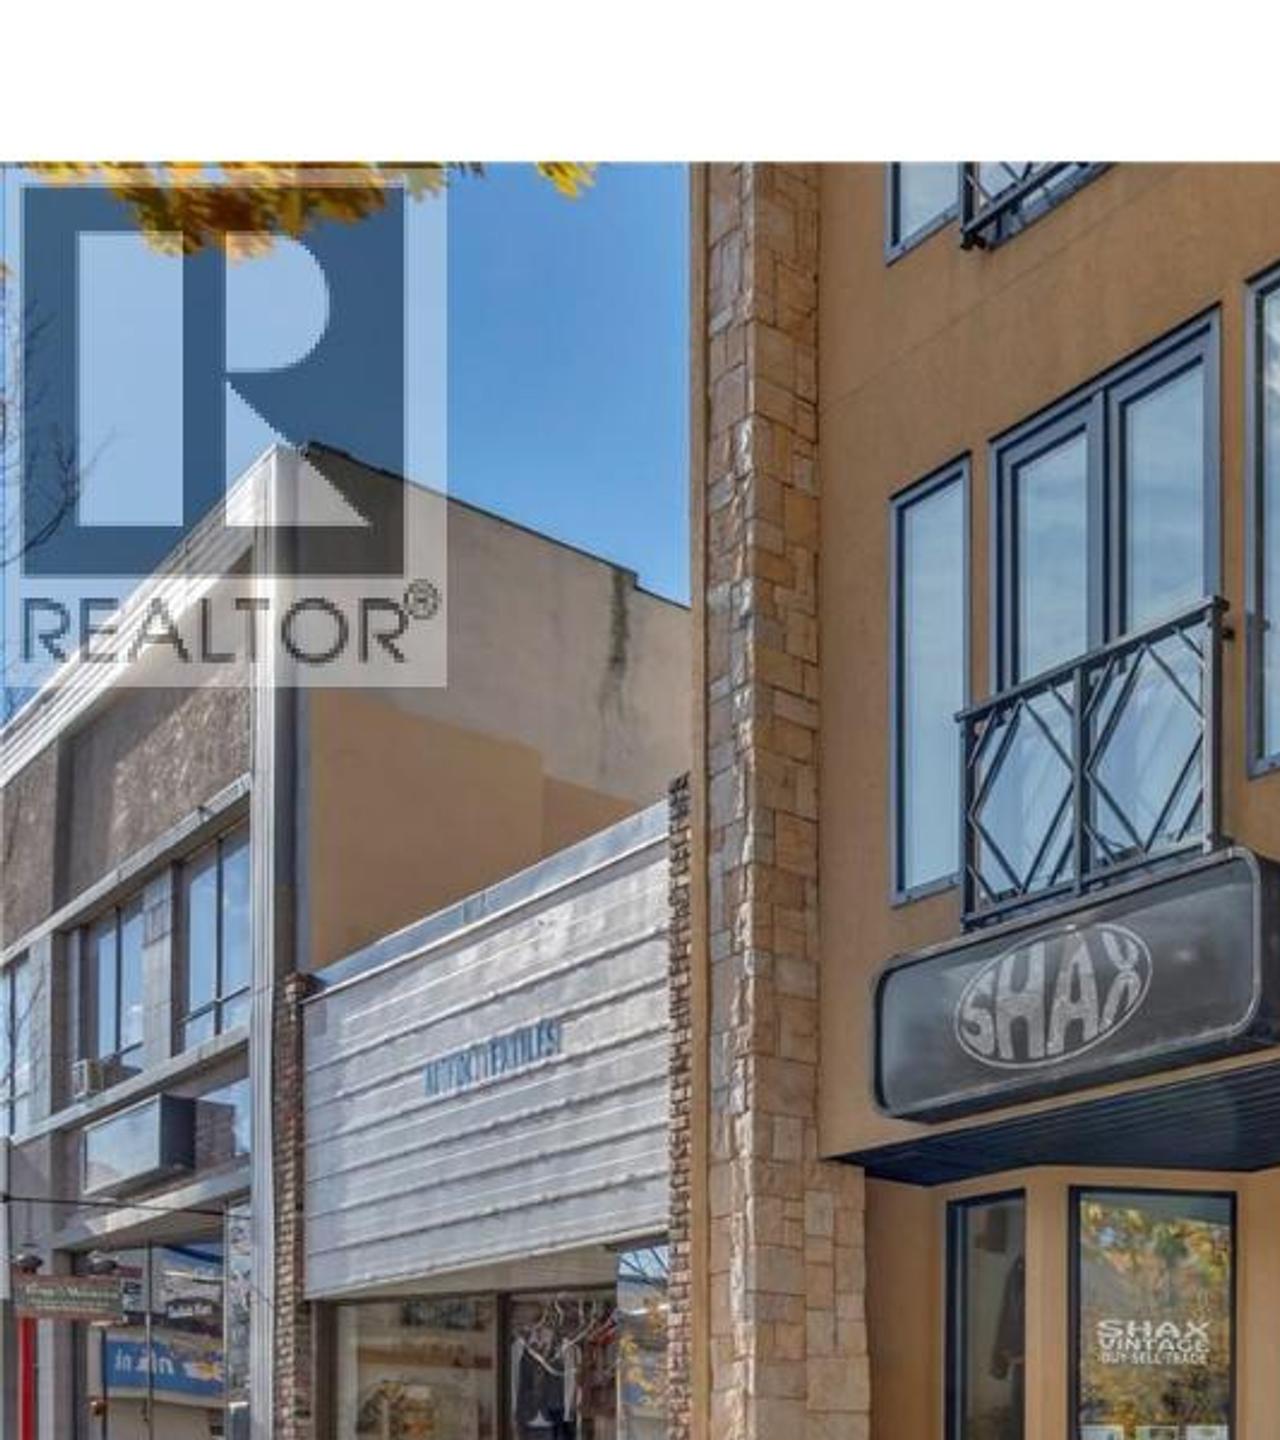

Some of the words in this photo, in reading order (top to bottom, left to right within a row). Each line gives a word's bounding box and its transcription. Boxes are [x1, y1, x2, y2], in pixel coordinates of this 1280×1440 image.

[961, 931, 1142, 1060] SHAX
[1097, 1320, 1210, 1338] SHAX
[1100, 1336, 1211, 1353] VINTAGE
